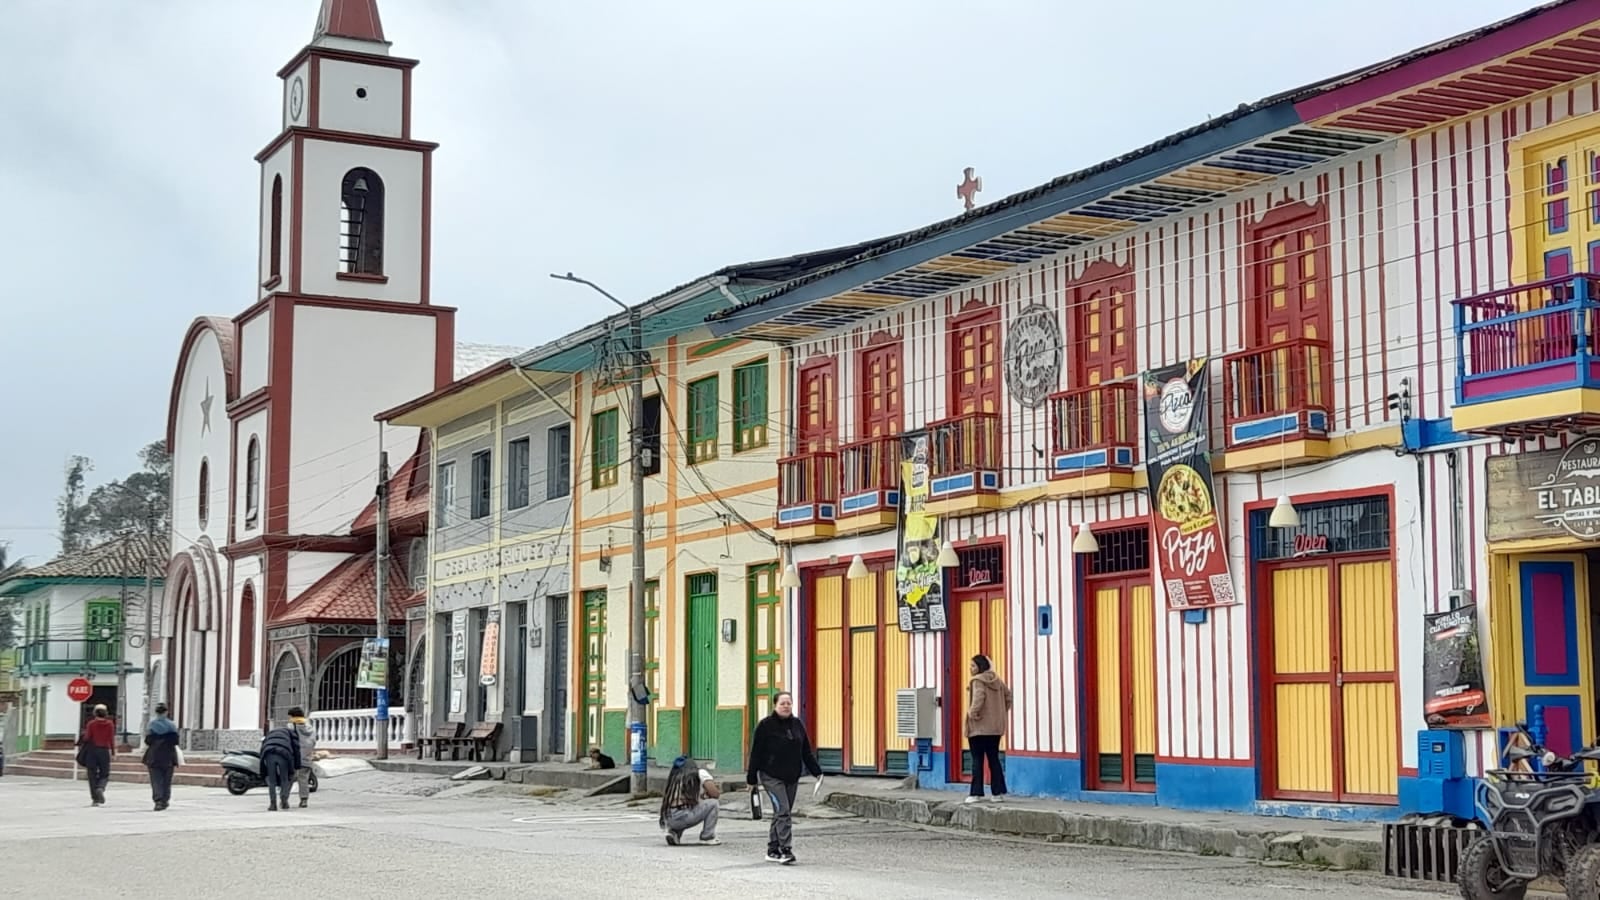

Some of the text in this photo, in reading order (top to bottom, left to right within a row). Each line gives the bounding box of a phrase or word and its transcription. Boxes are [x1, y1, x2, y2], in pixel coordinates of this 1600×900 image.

[1538, 486, 1600, 510] EL TABL
[1162, 526, 1217, 577] Pizza
[1295, 534, 1327, 554] Open
[969, 567, 991, 583] Open
[70, 685, 89, 694] PARE
